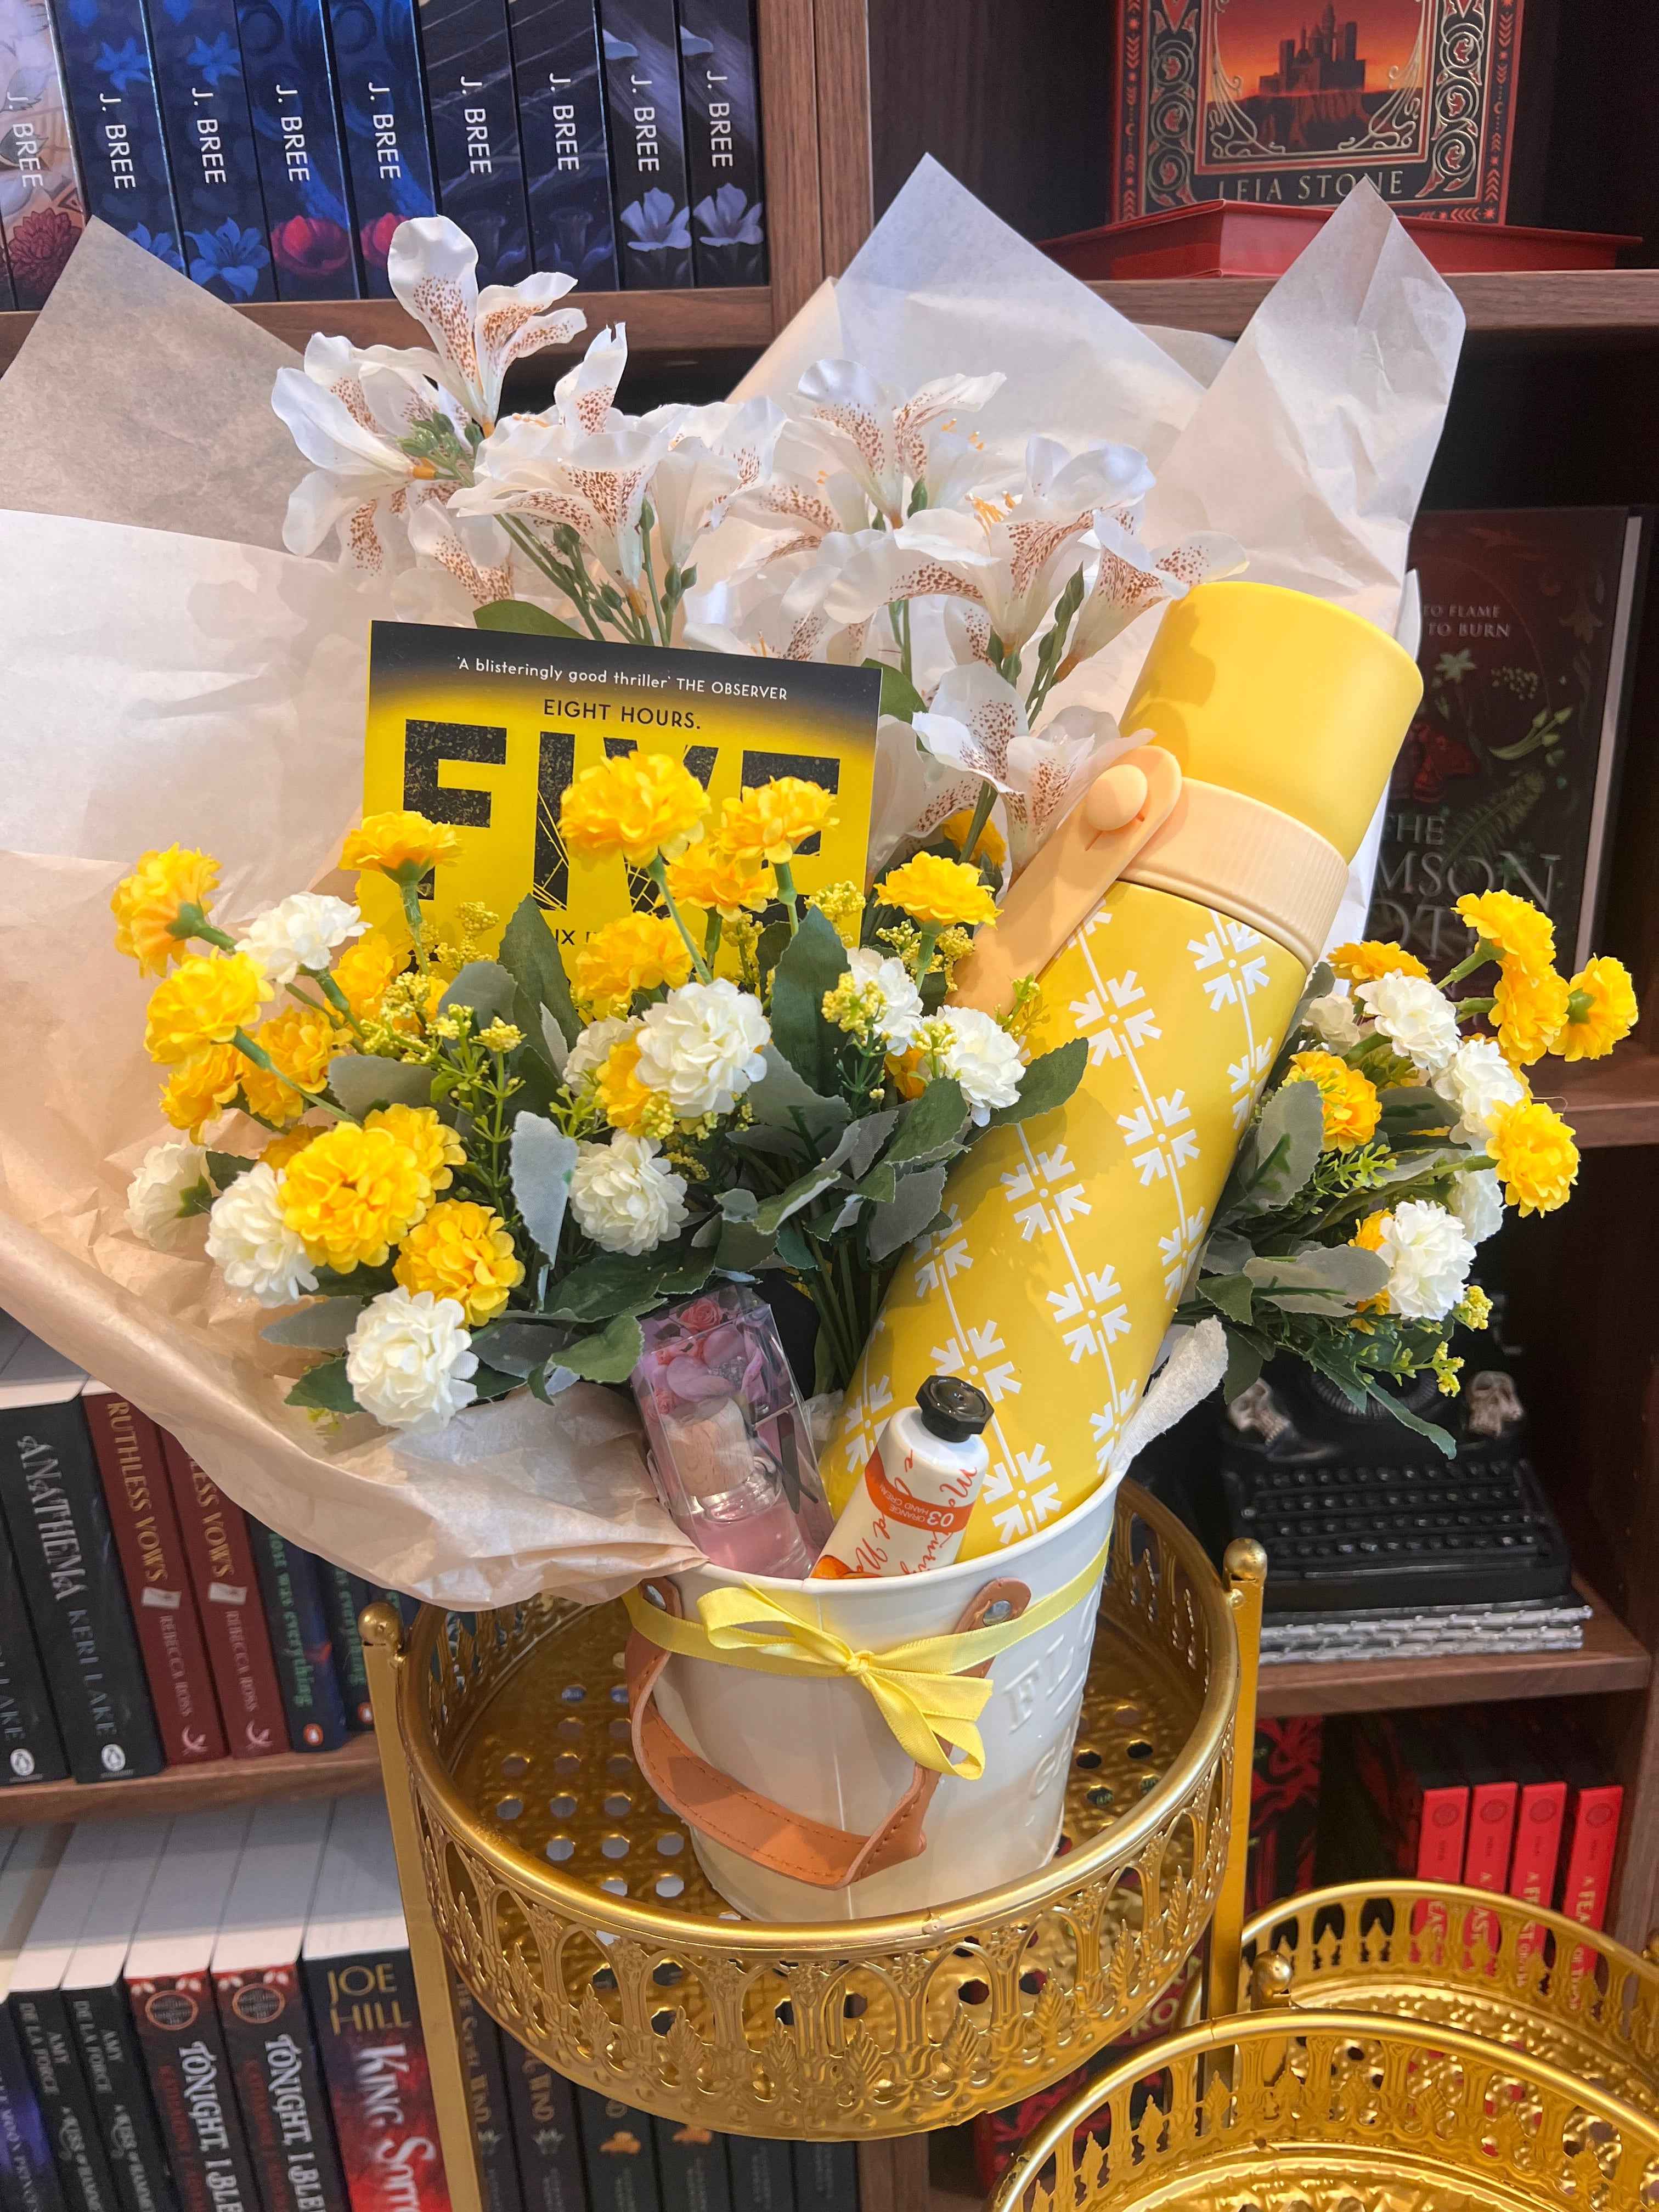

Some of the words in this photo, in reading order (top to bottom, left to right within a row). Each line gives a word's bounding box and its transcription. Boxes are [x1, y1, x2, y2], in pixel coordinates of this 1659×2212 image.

[191, 87, 213, 106] J.
[276, 84, 298, 103] J.
[368, 82, 390, 100] J.
[460, 76, 483, 94] J.
[549, 73, 571, 92] J.
[631, 74, 653, 93] J.
[706, 70, 728, 89] J.
[7, 92, 29, 109] J.
[99, 93, 121, 111] J.
[196, 119, 226, 184] BREE
[280, 116, 310, 182] BREE
[373, 114, 401, 179] BREE
[464, 108, 492, 174] BREE
[552, 105, 580, 171] BREE
[634, 107, 659, 172] BREE
[709, 103, 733, 167] BREE
[12, 123, 43, 187] BREE
[105, 124, 136, 189] BREE
[1428, 622, 1452, 636] TO
[1458, 623, 1511, 637] BURN
[1448, 605, 1502, 619] FLAME
[476, 659, 562, 681] blisteringly
[568, 670, 607, 684] good
[676, 678, 705, 692] THE
[711, 681, 787, 701] OBSERVER
[543, 698, 611, 721] EIGHT
[621, 706, 701, 730] HOURS.
[107, 1400, 153, 1513] RUTHLESS
[134, 1516, 168, 1582] VOWS
[904, 1502, 929, 1515] HAND
[16, 1435, 90, 1601] ANATHEMA
[889, 1504, 926, 1522] ORANGE
[927, 1510, 955, 1528] 03
[202, 1511, 235, 1578] VOWS
[67, 1609, 100, 1664] KERI
[83, 1673, 117, 1736] LAKE
[328, 1962, 398, 2004] JOE
[330, 2000, 413, 2036] HILL
[355, 2044, 410, 2128] KING
[204, 2158, 233, 2171] I
[287, 2151, 315, 2162] I
